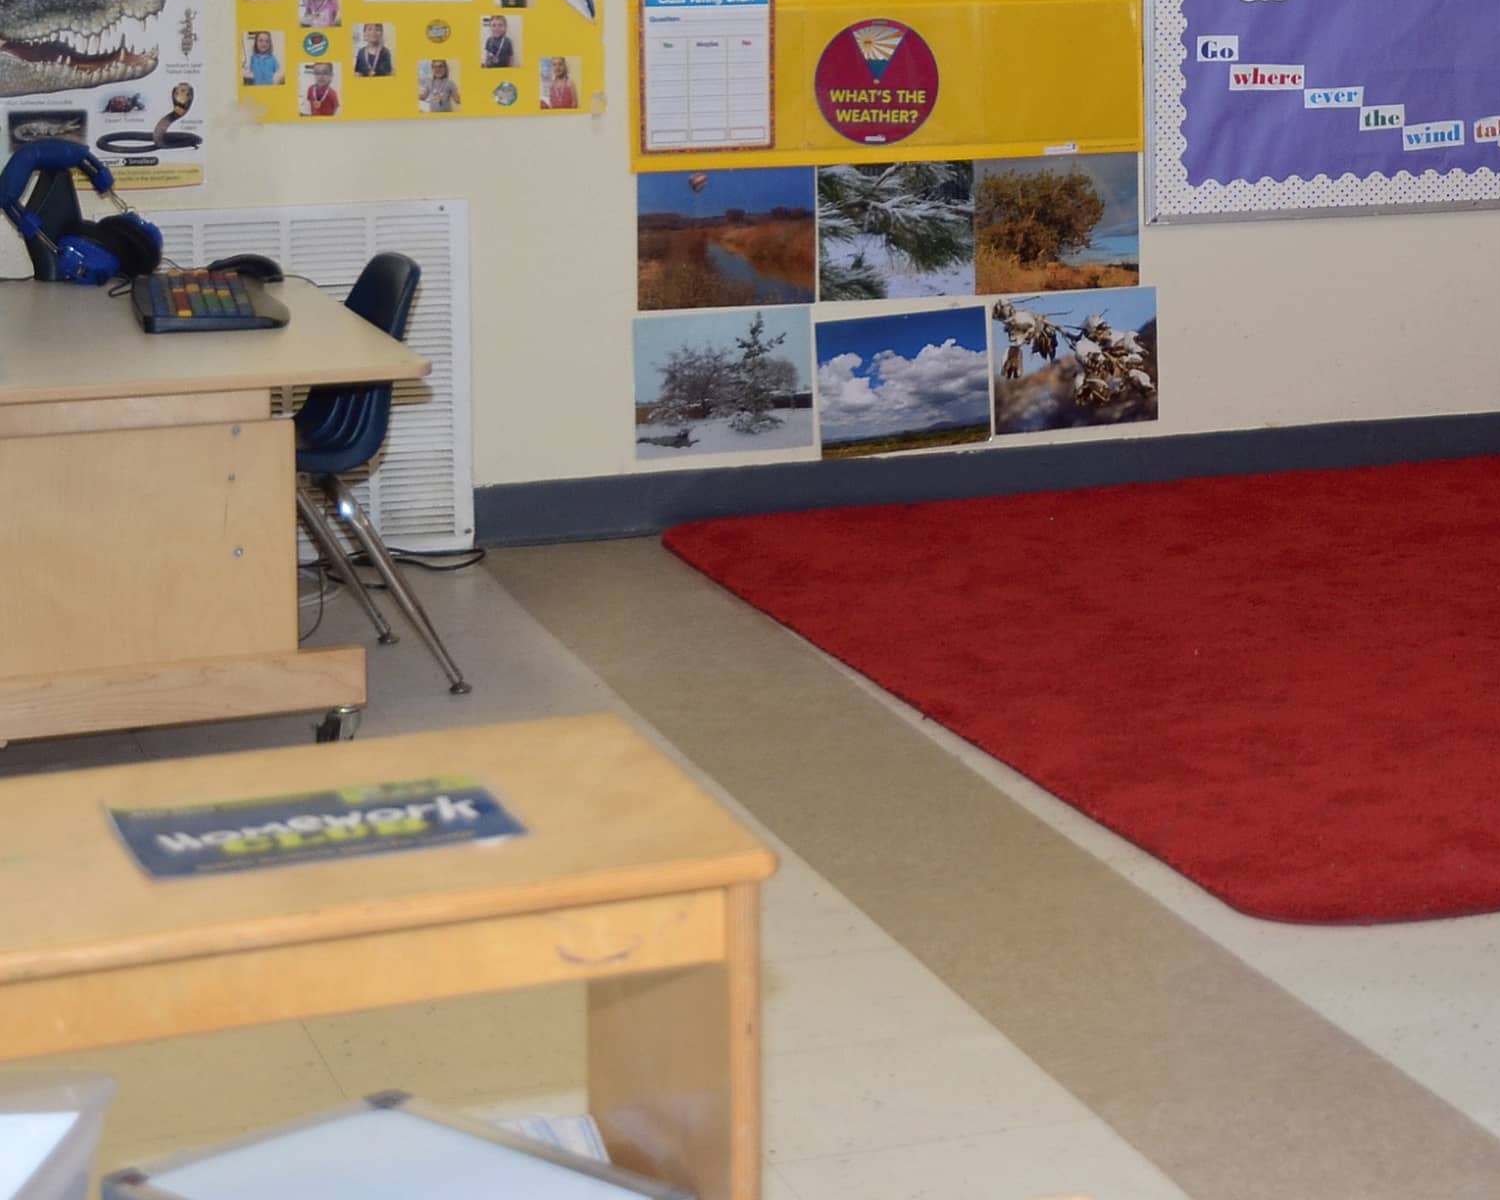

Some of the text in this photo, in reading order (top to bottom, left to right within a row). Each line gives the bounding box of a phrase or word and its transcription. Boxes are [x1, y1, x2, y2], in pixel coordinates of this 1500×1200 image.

[1201, 41, 1233, 59] Go
[1233, 69, 1303, 87] where
[829, 89, 926, 104] WHAT'S THE
[1310, 89, 1358, 105] ever
[836, 109, 918, 123] WEATHER?
[1364, 110, 1400, 127] the
[1405, 125, 1461, 144] wind
[156, 795, 480, 853] Homework
